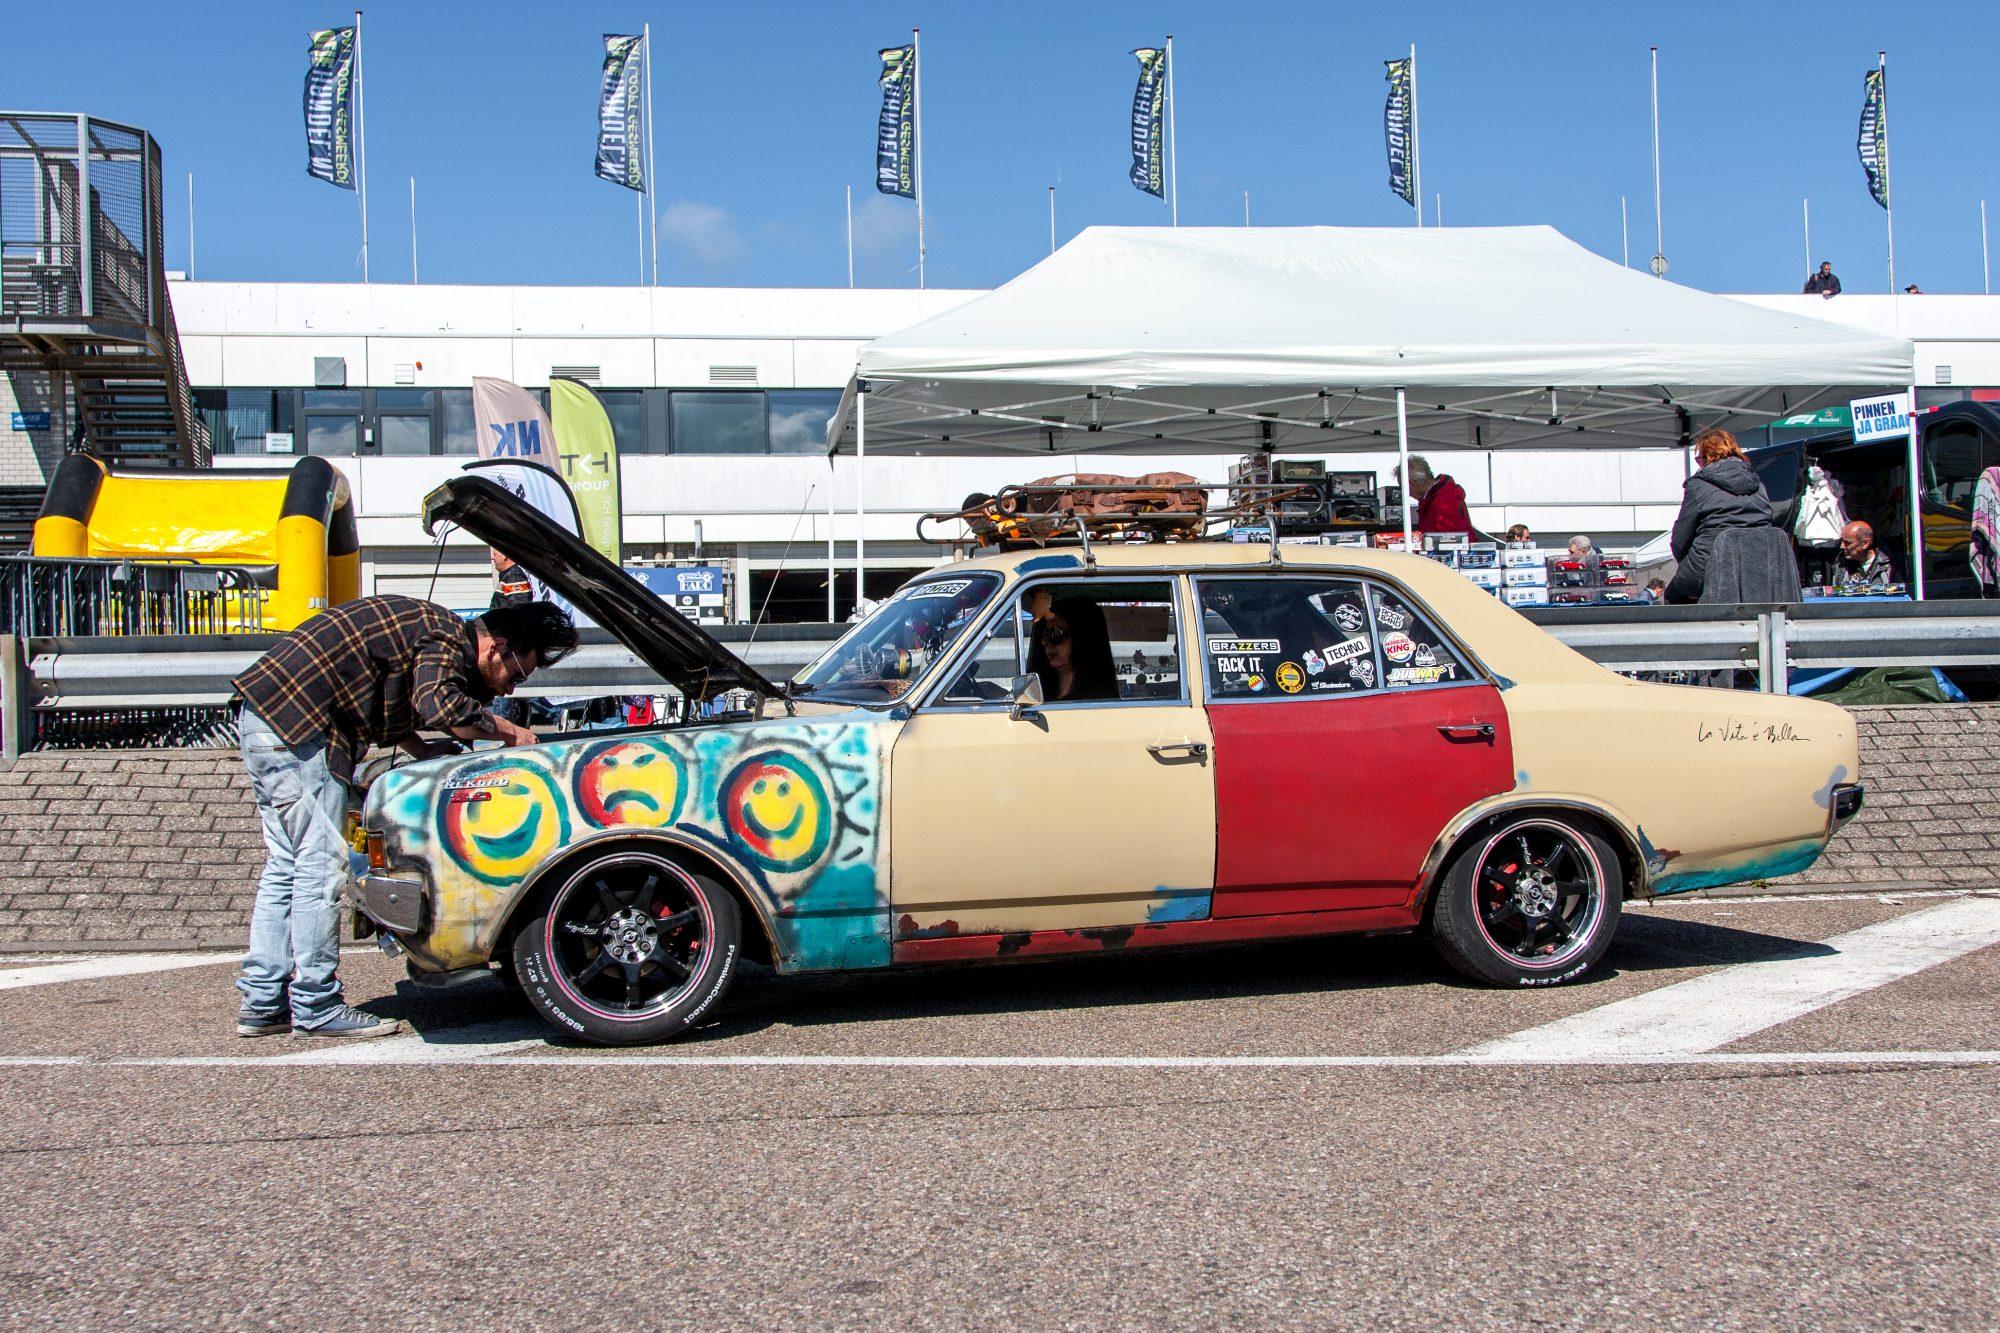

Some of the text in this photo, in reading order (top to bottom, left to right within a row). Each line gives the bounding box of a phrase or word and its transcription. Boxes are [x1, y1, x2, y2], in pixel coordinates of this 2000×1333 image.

[1854, 401, 1895, 420] PINNEN
[1857, 420, 1872, 434] JA
[1212, 642, 1278, 651] BRAZZERS
[1326, 640, 1367, 661] TECHNO.
[1387, 643, 1410, 655] KING
[1217, 657, 1247, 673] FACK
[1248, 657, 1264, 673] IT.
[1718, 714, 1748, 742] Vita
[1763, 722, 1812, 744] Bella
[1519, 961, 1588, 985] NEXEN
